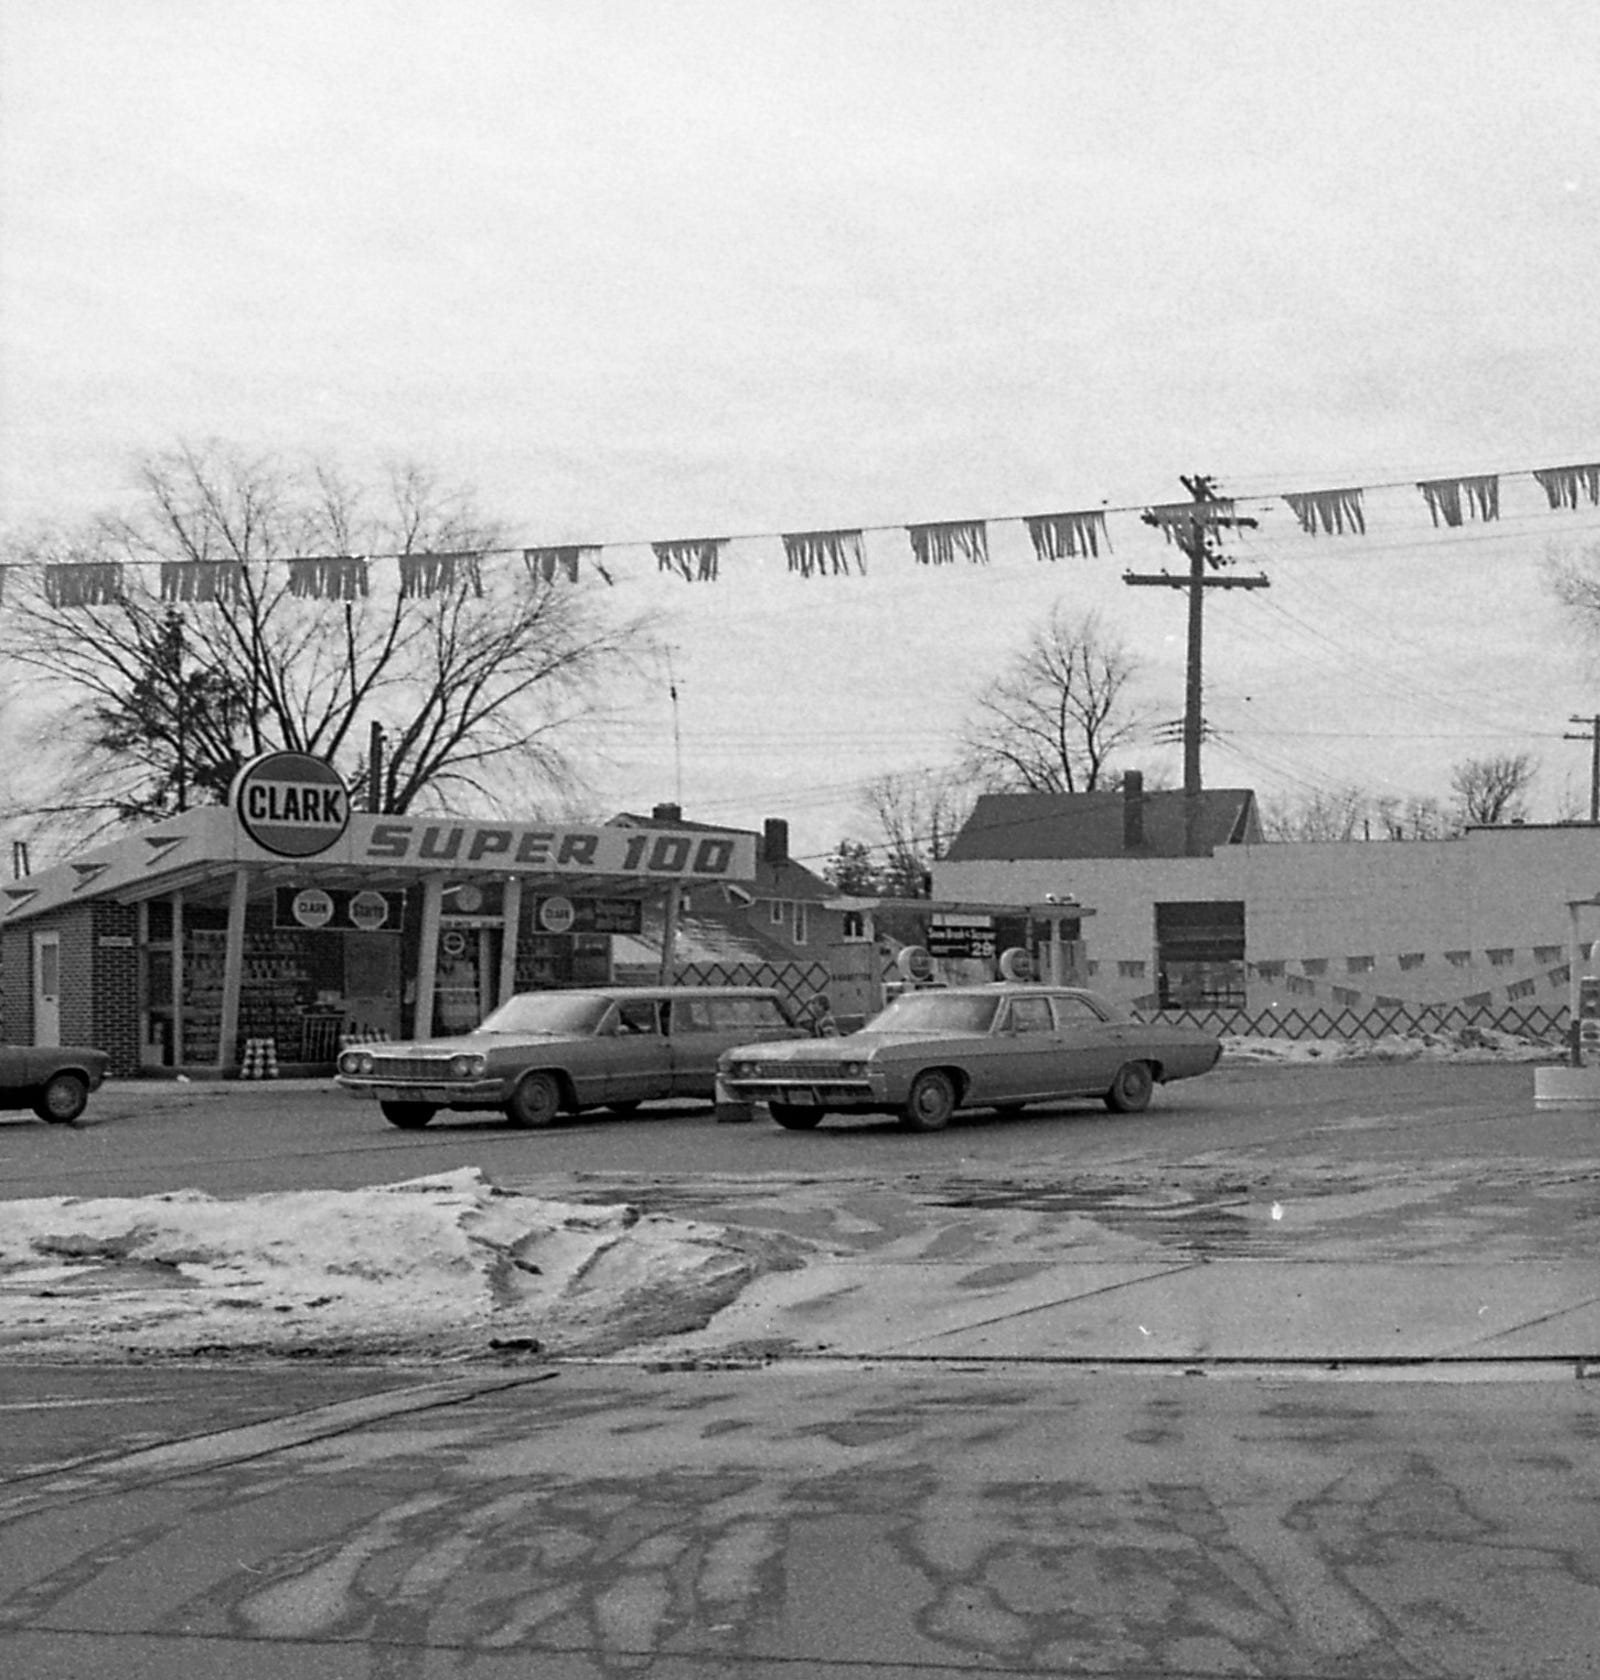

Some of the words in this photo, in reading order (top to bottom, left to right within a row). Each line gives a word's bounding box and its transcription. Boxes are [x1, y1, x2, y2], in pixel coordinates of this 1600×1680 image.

[248, 784, 342, 823] CLARK
[366, 823, 599, 866] SUPER
[622, 834, 735, 873] 100
